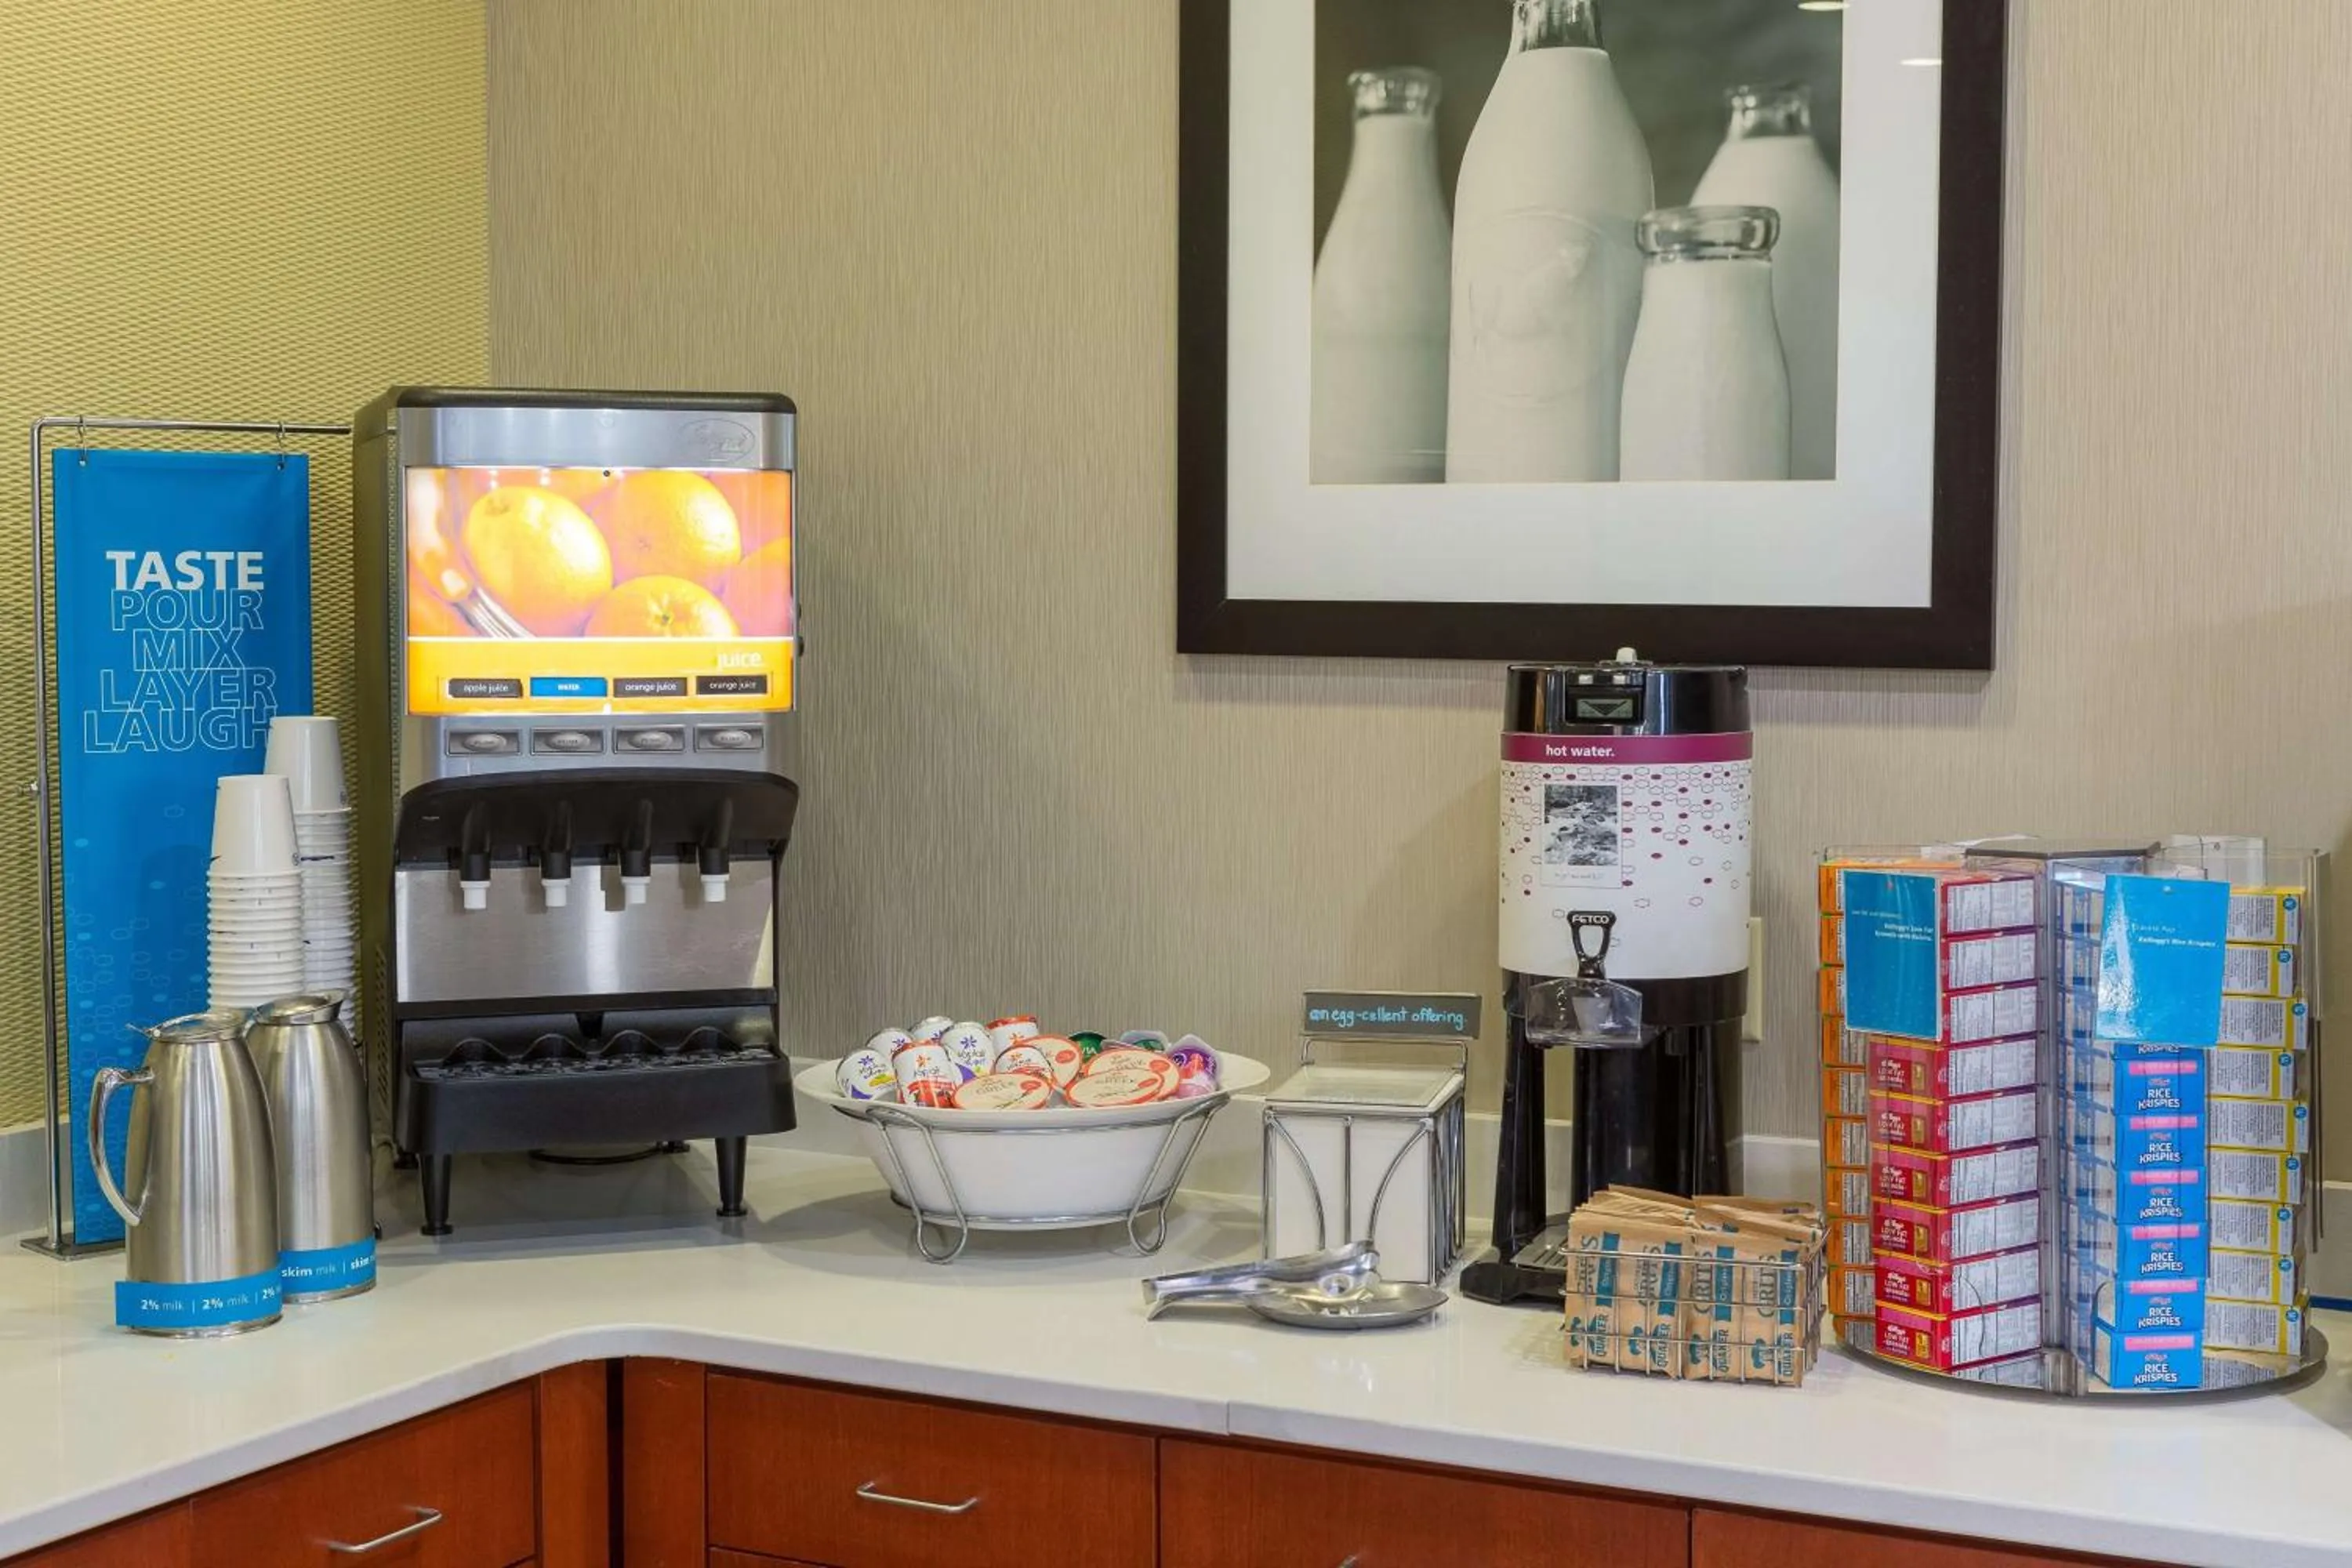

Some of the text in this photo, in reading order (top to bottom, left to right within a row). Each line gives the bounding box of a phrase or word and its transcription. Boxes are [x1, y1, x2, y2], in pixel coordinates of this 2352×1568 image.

[105, 550, 264, 590] TASTE
[111, 589, 264, 630] POUR
[133, 629, 245, 670] MIX
[717, 652, 762, 671] juice
[100, 668, 278, 712] LAYER
[463, 684, 487, 692] apple
[625, 683, 677, 692] orange juice
[709, 681, 757, 690] orange juice
[84, 706, 276, 753] LAUGH
[1545, 744, 1615, 757] hot water.
[1571, 914, 1610, 924] FETCO
[1332, 1006, 1406, 1028] egg-cellent
[2147, 1087, 2171, 1098] RICE
[2138, 1098, 2180, 1111] KRISPIES
[2149, 1142, 2172, 1153] RICE
[2140, 1152, 2181, 1164] KRISPIES
[2150, 1197, 2173, 1207] RICE
[2140, 1207, 2183, 1219] KRISPIES
[2151, 1252, 2174, 1263] RICE
[281, 1266, 313, 1277] skim
[2141, 1261, 2183, 1274] KRISPIES
[1693, 1251, 1713, 1313] GRITS
[1757, 1254, 1777, 1318] GRITS
[140, 1299, 159, 1310] 2%
[162, 1301, 183, 1311] milk
[201, 1298, 223, 1310] 2%
[2149, 1307, 2172, 1318] RICE
[2138, 1316, 2181, 1329] KRISPIES
[2144, 1363, 2169, 1374] RICE
[2134, 1373, 2177, 1385] KRISPIES
